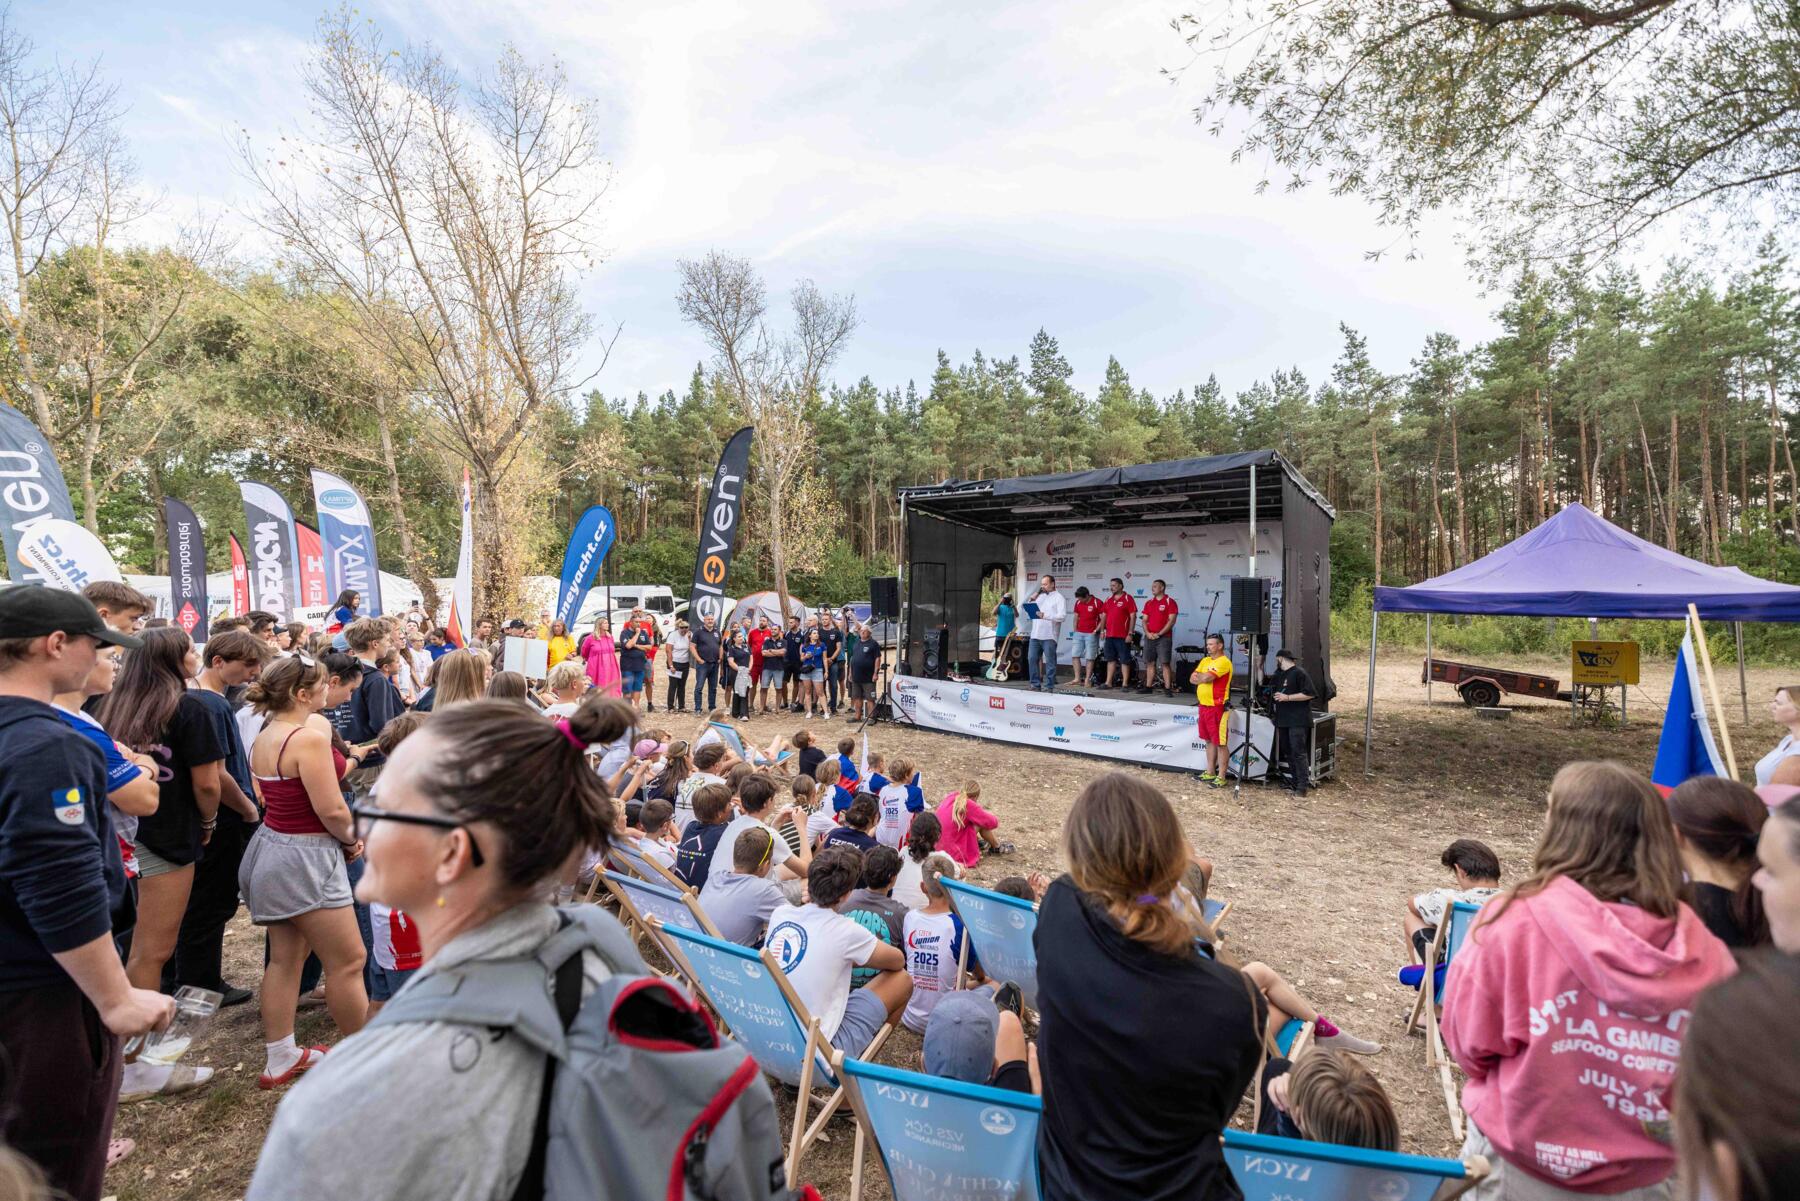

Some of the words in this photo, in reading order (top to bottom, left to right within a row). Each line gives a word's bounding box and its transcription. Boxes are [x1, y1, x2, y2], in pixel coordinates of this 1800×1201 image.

[1051, 557, 1075, 568] 2025
[900, 693, 917, 704] 2025
[885, 807, 899, 815] 2025
[915, 935, 941, 945] JUNIOR
[914, 951, 939, 966] 2025
[1566, 1016, 1600, 1040] LA
[1606, 1026, 1681, 1058] GAMB
[1551, 1039, 1619, 1063] SEAFOOD
[1578, 1068, 1637, 1098] JULY
[1579, 1149, 1608, 1163] WELL
